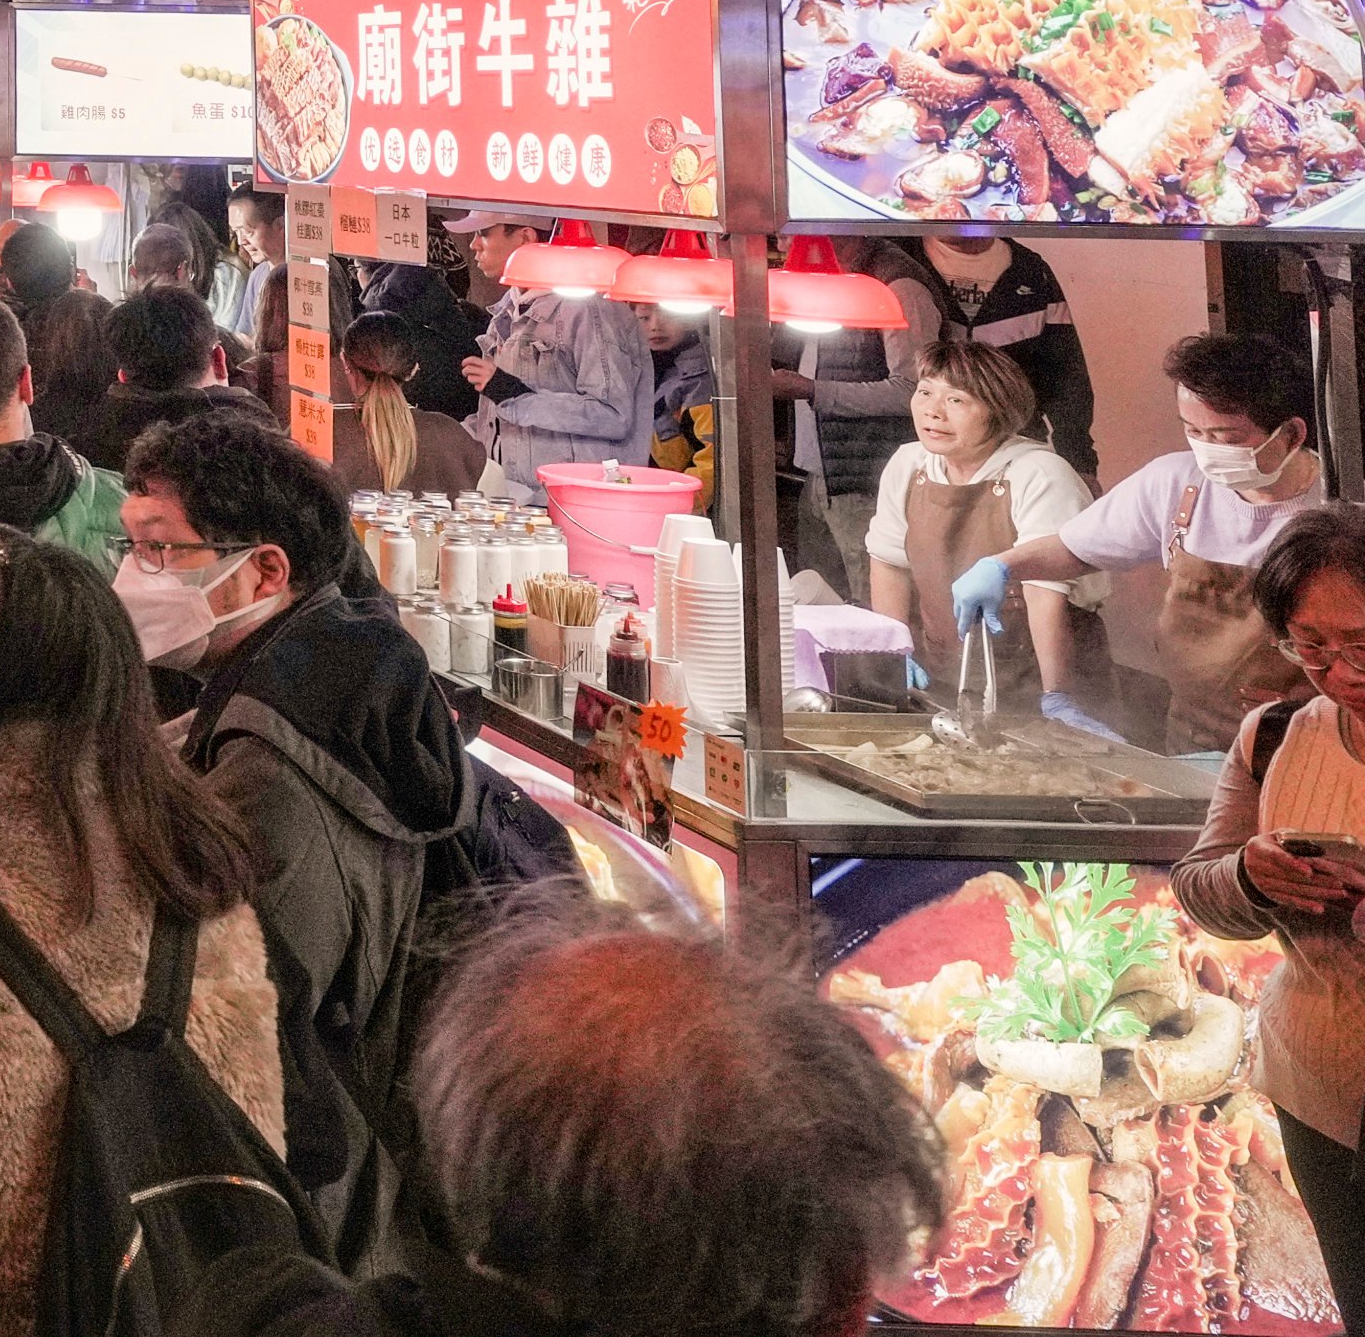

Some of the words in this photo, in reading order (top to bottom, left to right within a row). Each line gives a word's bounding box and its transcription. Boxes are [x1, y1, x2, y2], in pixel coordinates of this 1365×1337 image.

[60, 104, 106, 121] 雞肉腸
[111, 107, 126, 119] $5
[191, 102, 225, 120] 魚蛋
[392, 204, 410, 221] 日本
[384, 232, 420, 249] 一口牛粒
[302, 302, 314, 318] $38
[304, 364, 316, 380] $38
[306, 429, 318, 446] $38
[646, 712, 672, 743] 50
